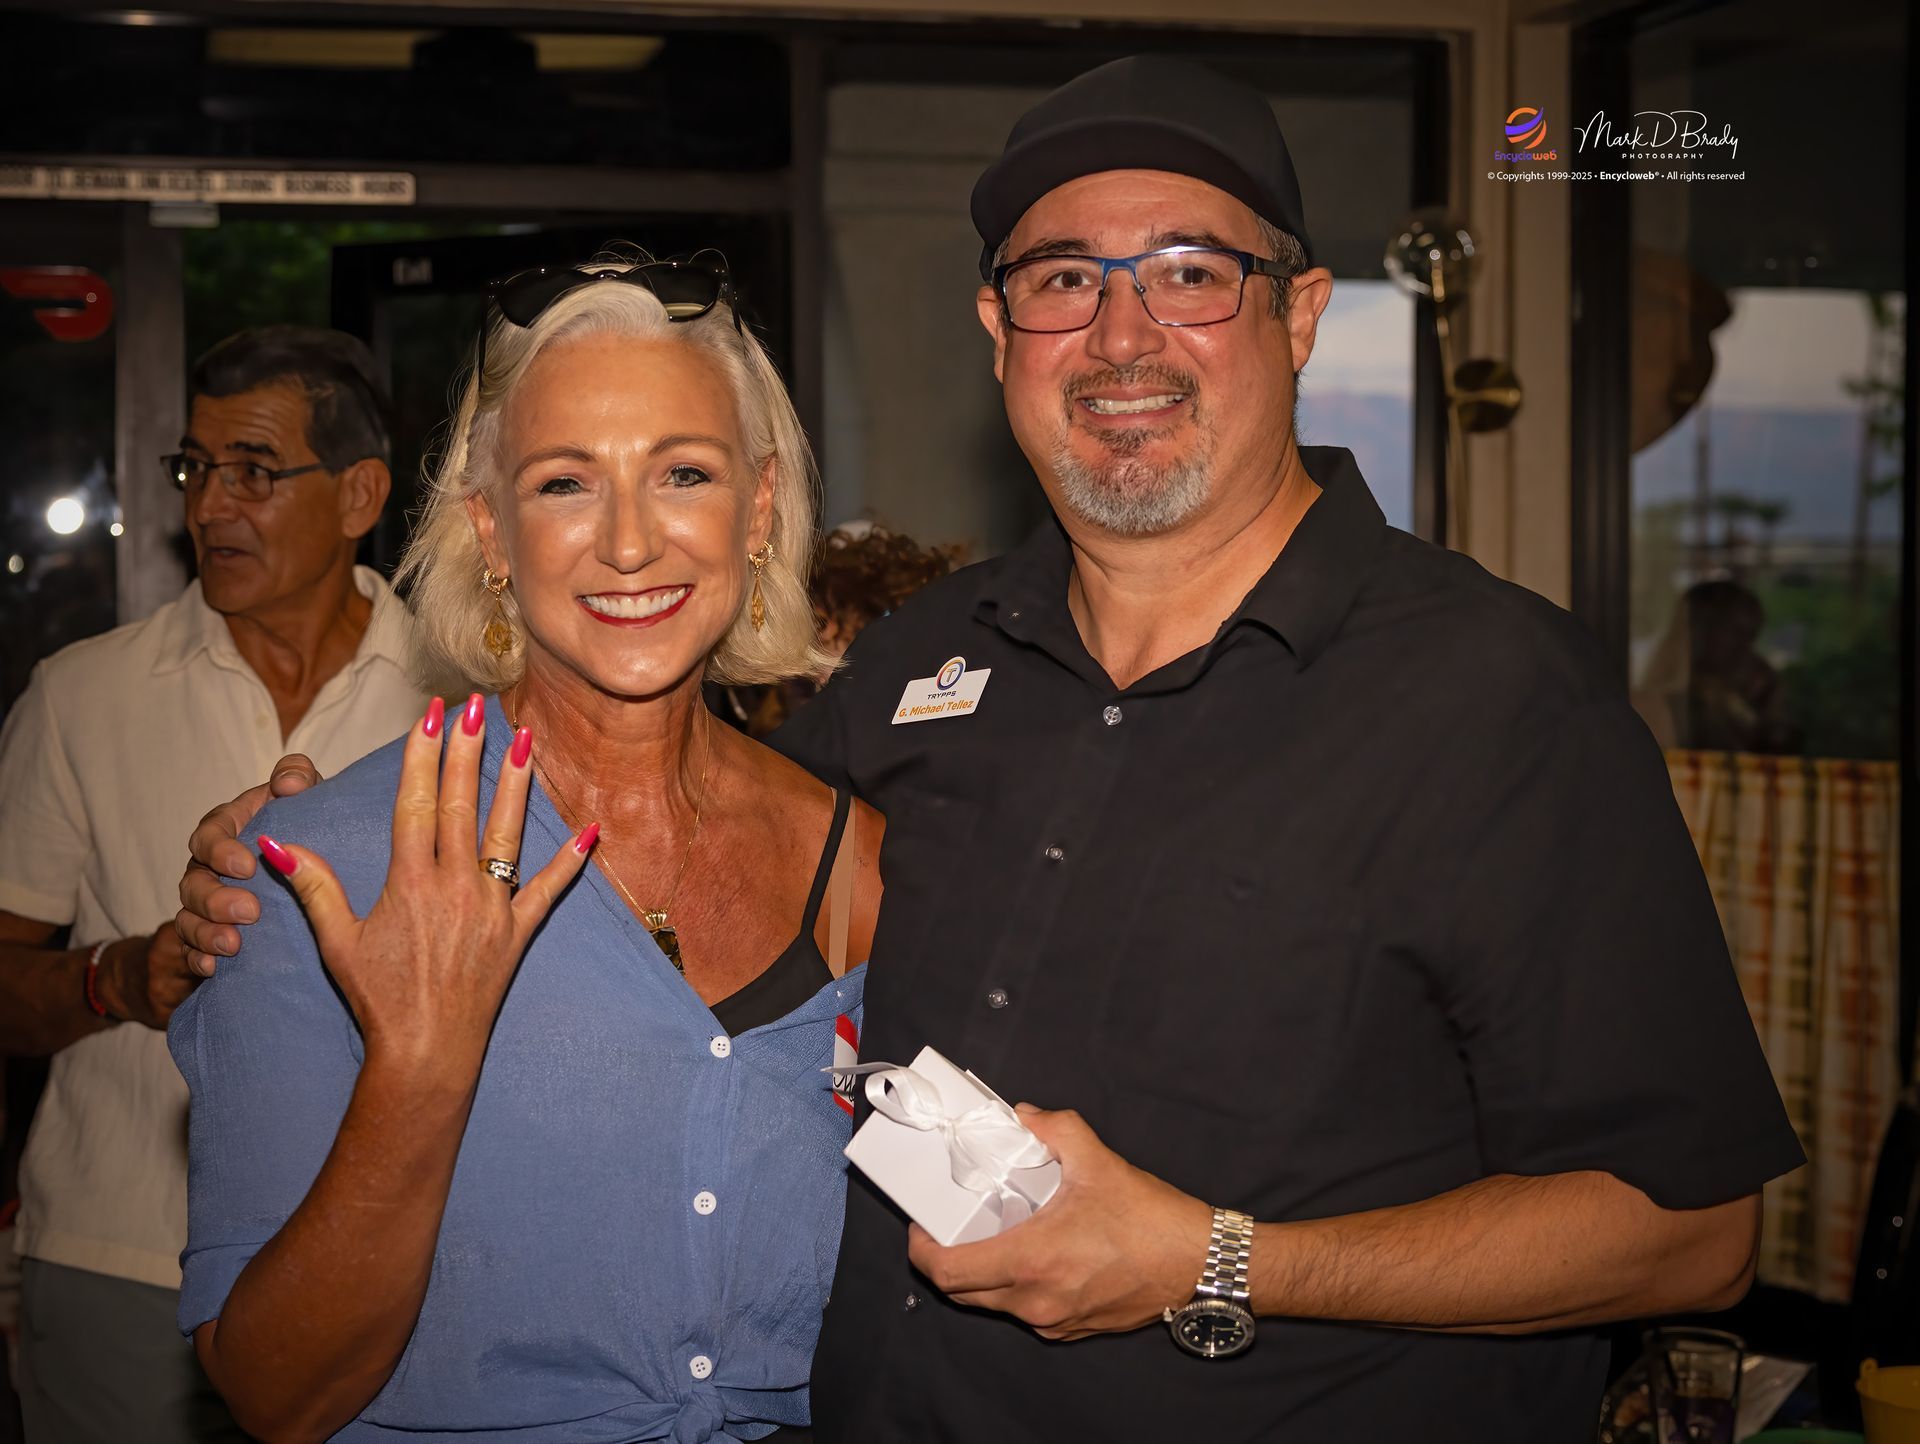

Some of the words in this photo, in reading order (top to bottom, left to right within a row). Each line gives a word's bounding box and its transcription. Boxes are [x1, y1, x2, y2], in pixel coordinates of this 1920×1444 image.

[927, 690, 957, 700] TRYPPS
[898, 708, 908, 718] G.
[909, 703, 945, 716] Michael
[947, 700, 975, 712] Tellez
